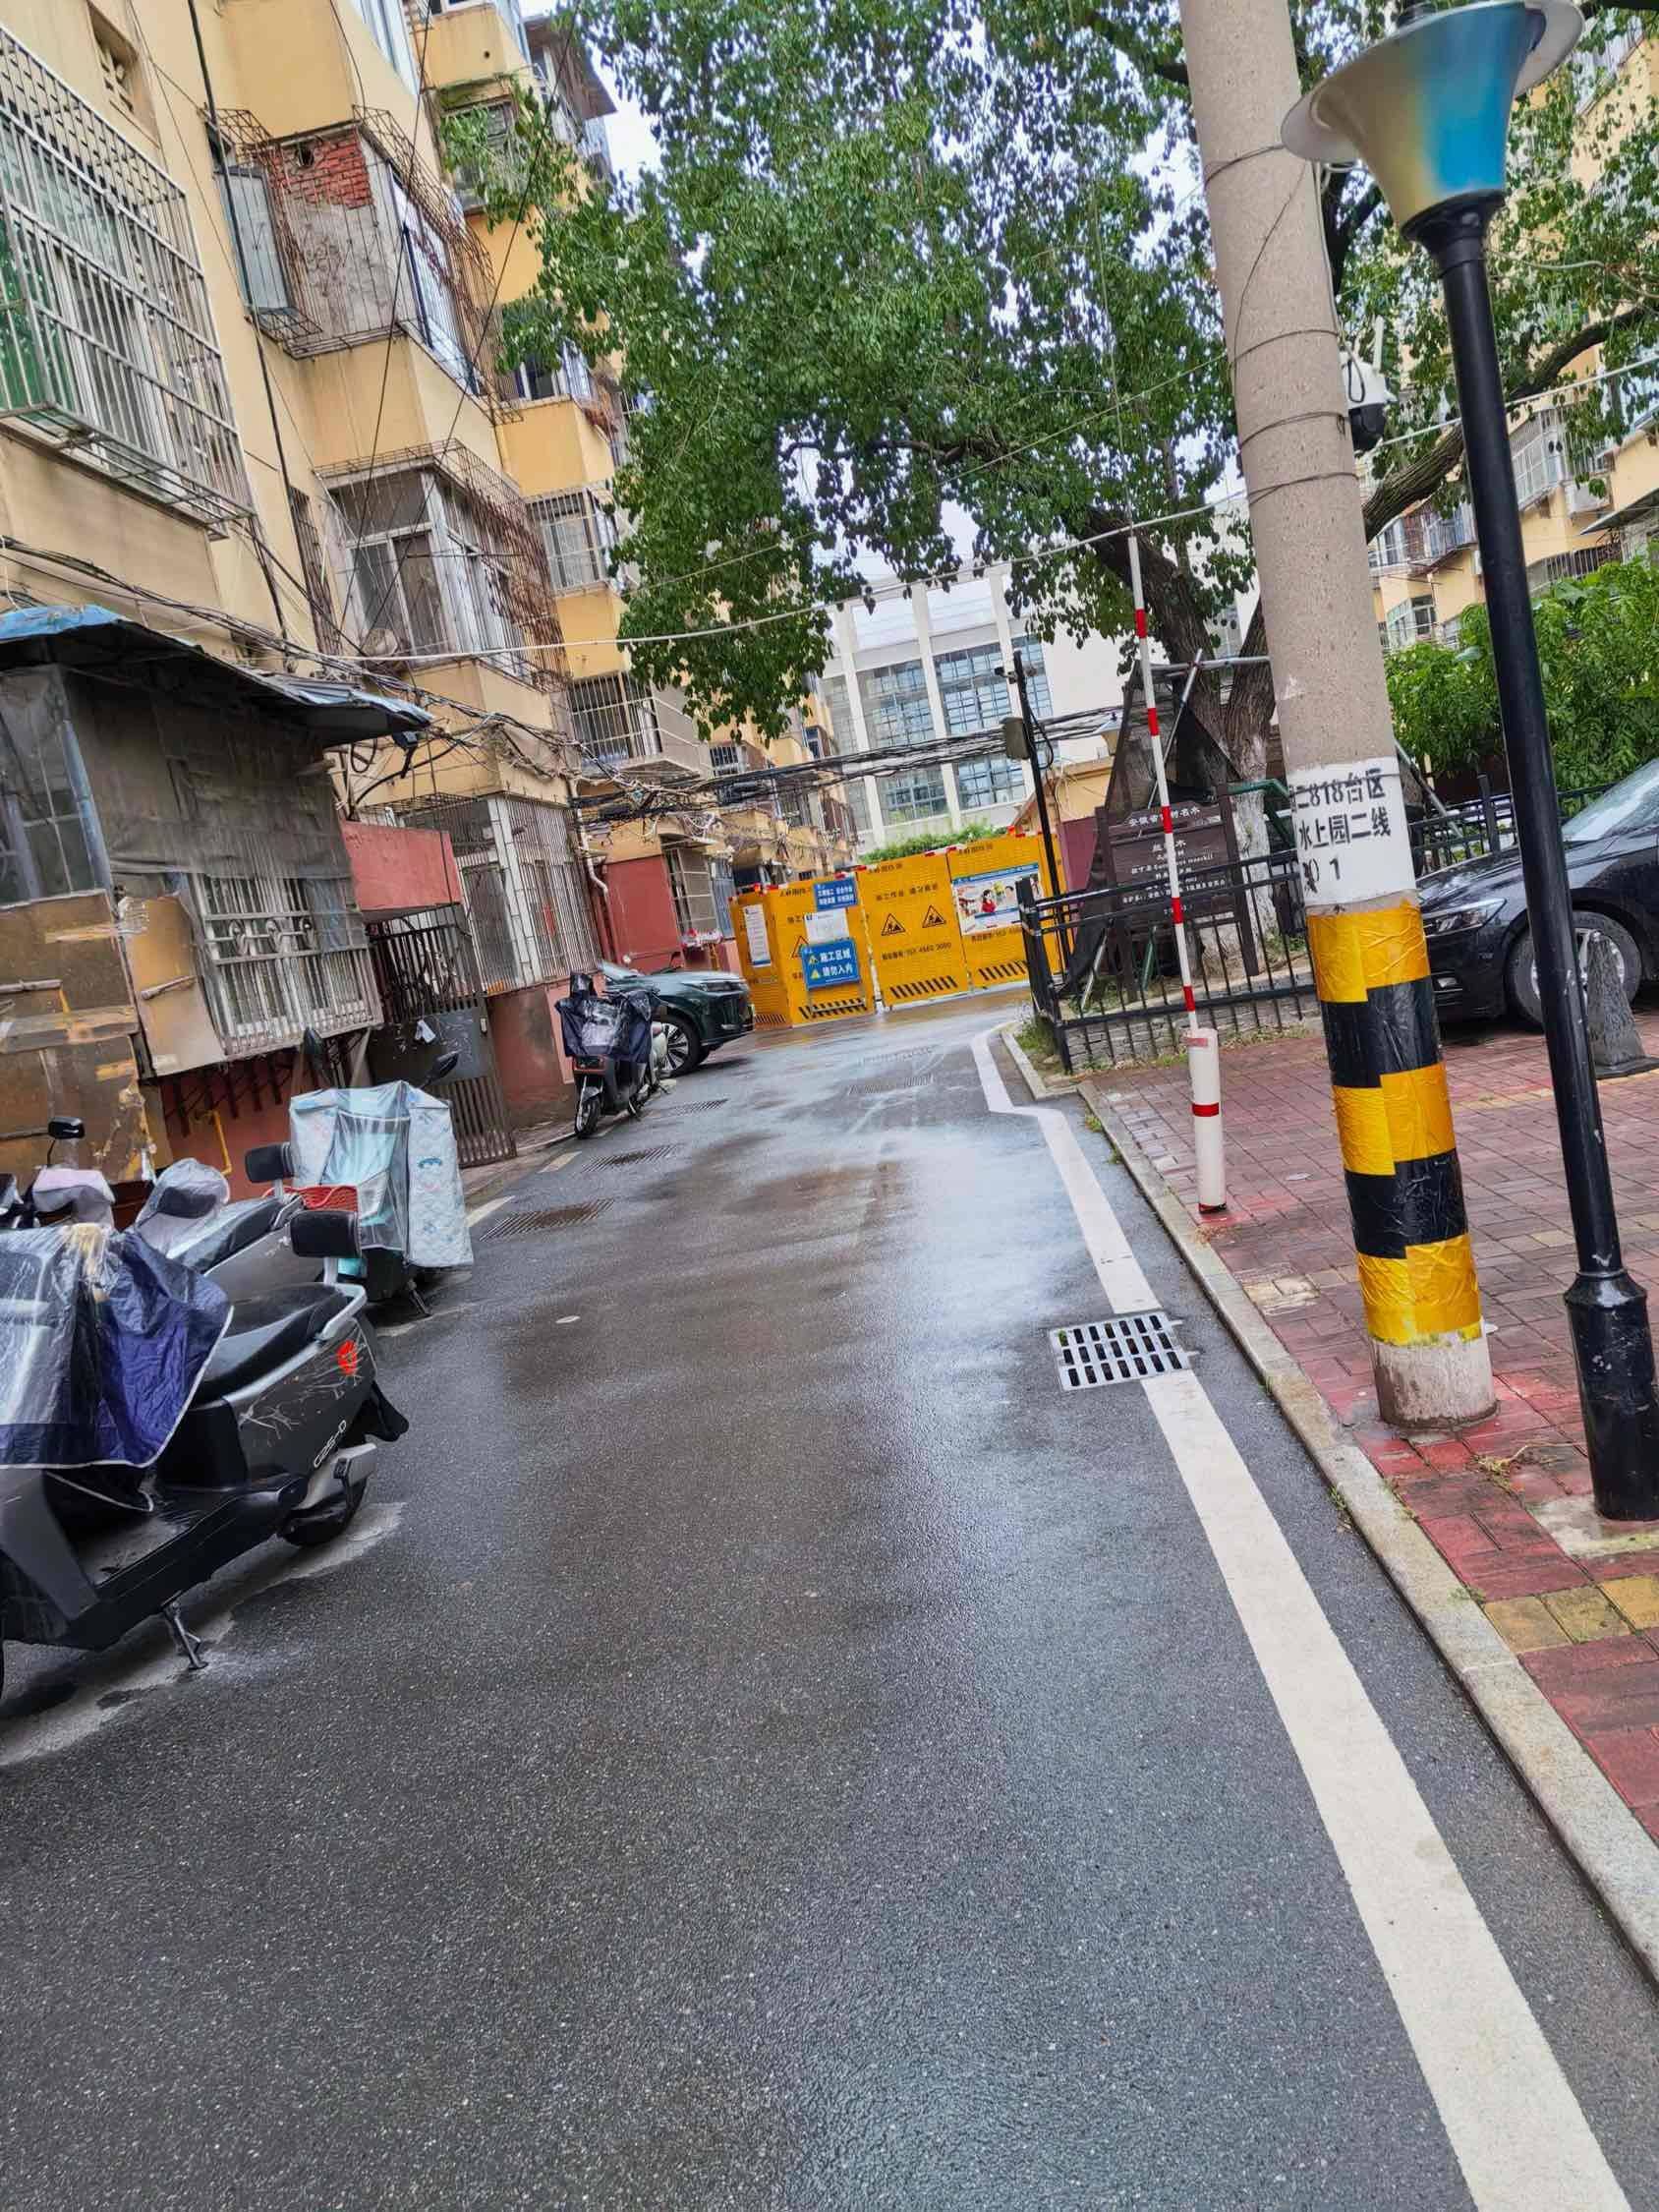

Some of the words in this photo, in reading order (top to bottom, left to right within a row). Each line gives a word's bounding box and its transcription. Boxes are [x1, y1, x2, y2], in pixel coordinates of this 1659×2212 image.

[1298, 806, 1391, 850] 水上园二线
